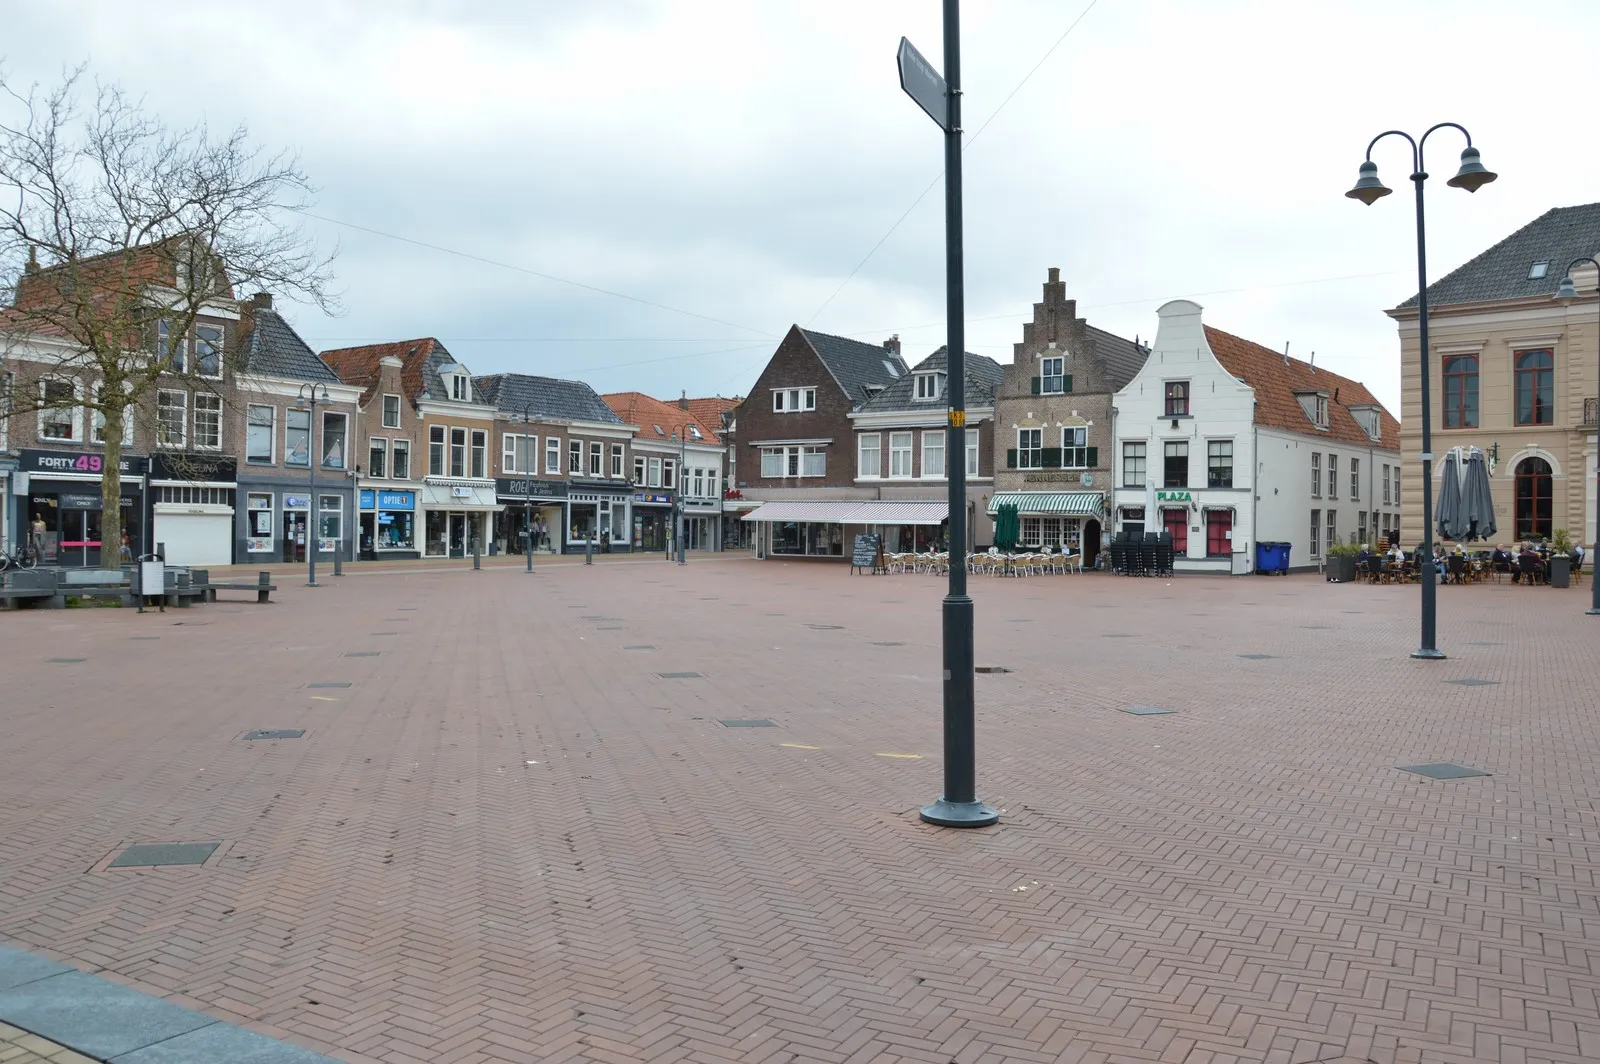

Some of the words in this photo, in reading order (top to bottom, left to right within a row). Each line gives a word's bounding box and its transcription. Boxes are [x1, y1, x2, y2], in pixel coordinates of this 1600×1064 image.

[38, 456, 75, 467] FORTY
[75, 455, 102, 471] 49
[530, 481, 550, 489] Fashion
[1157, 491, 1192, 502] PLAZA
